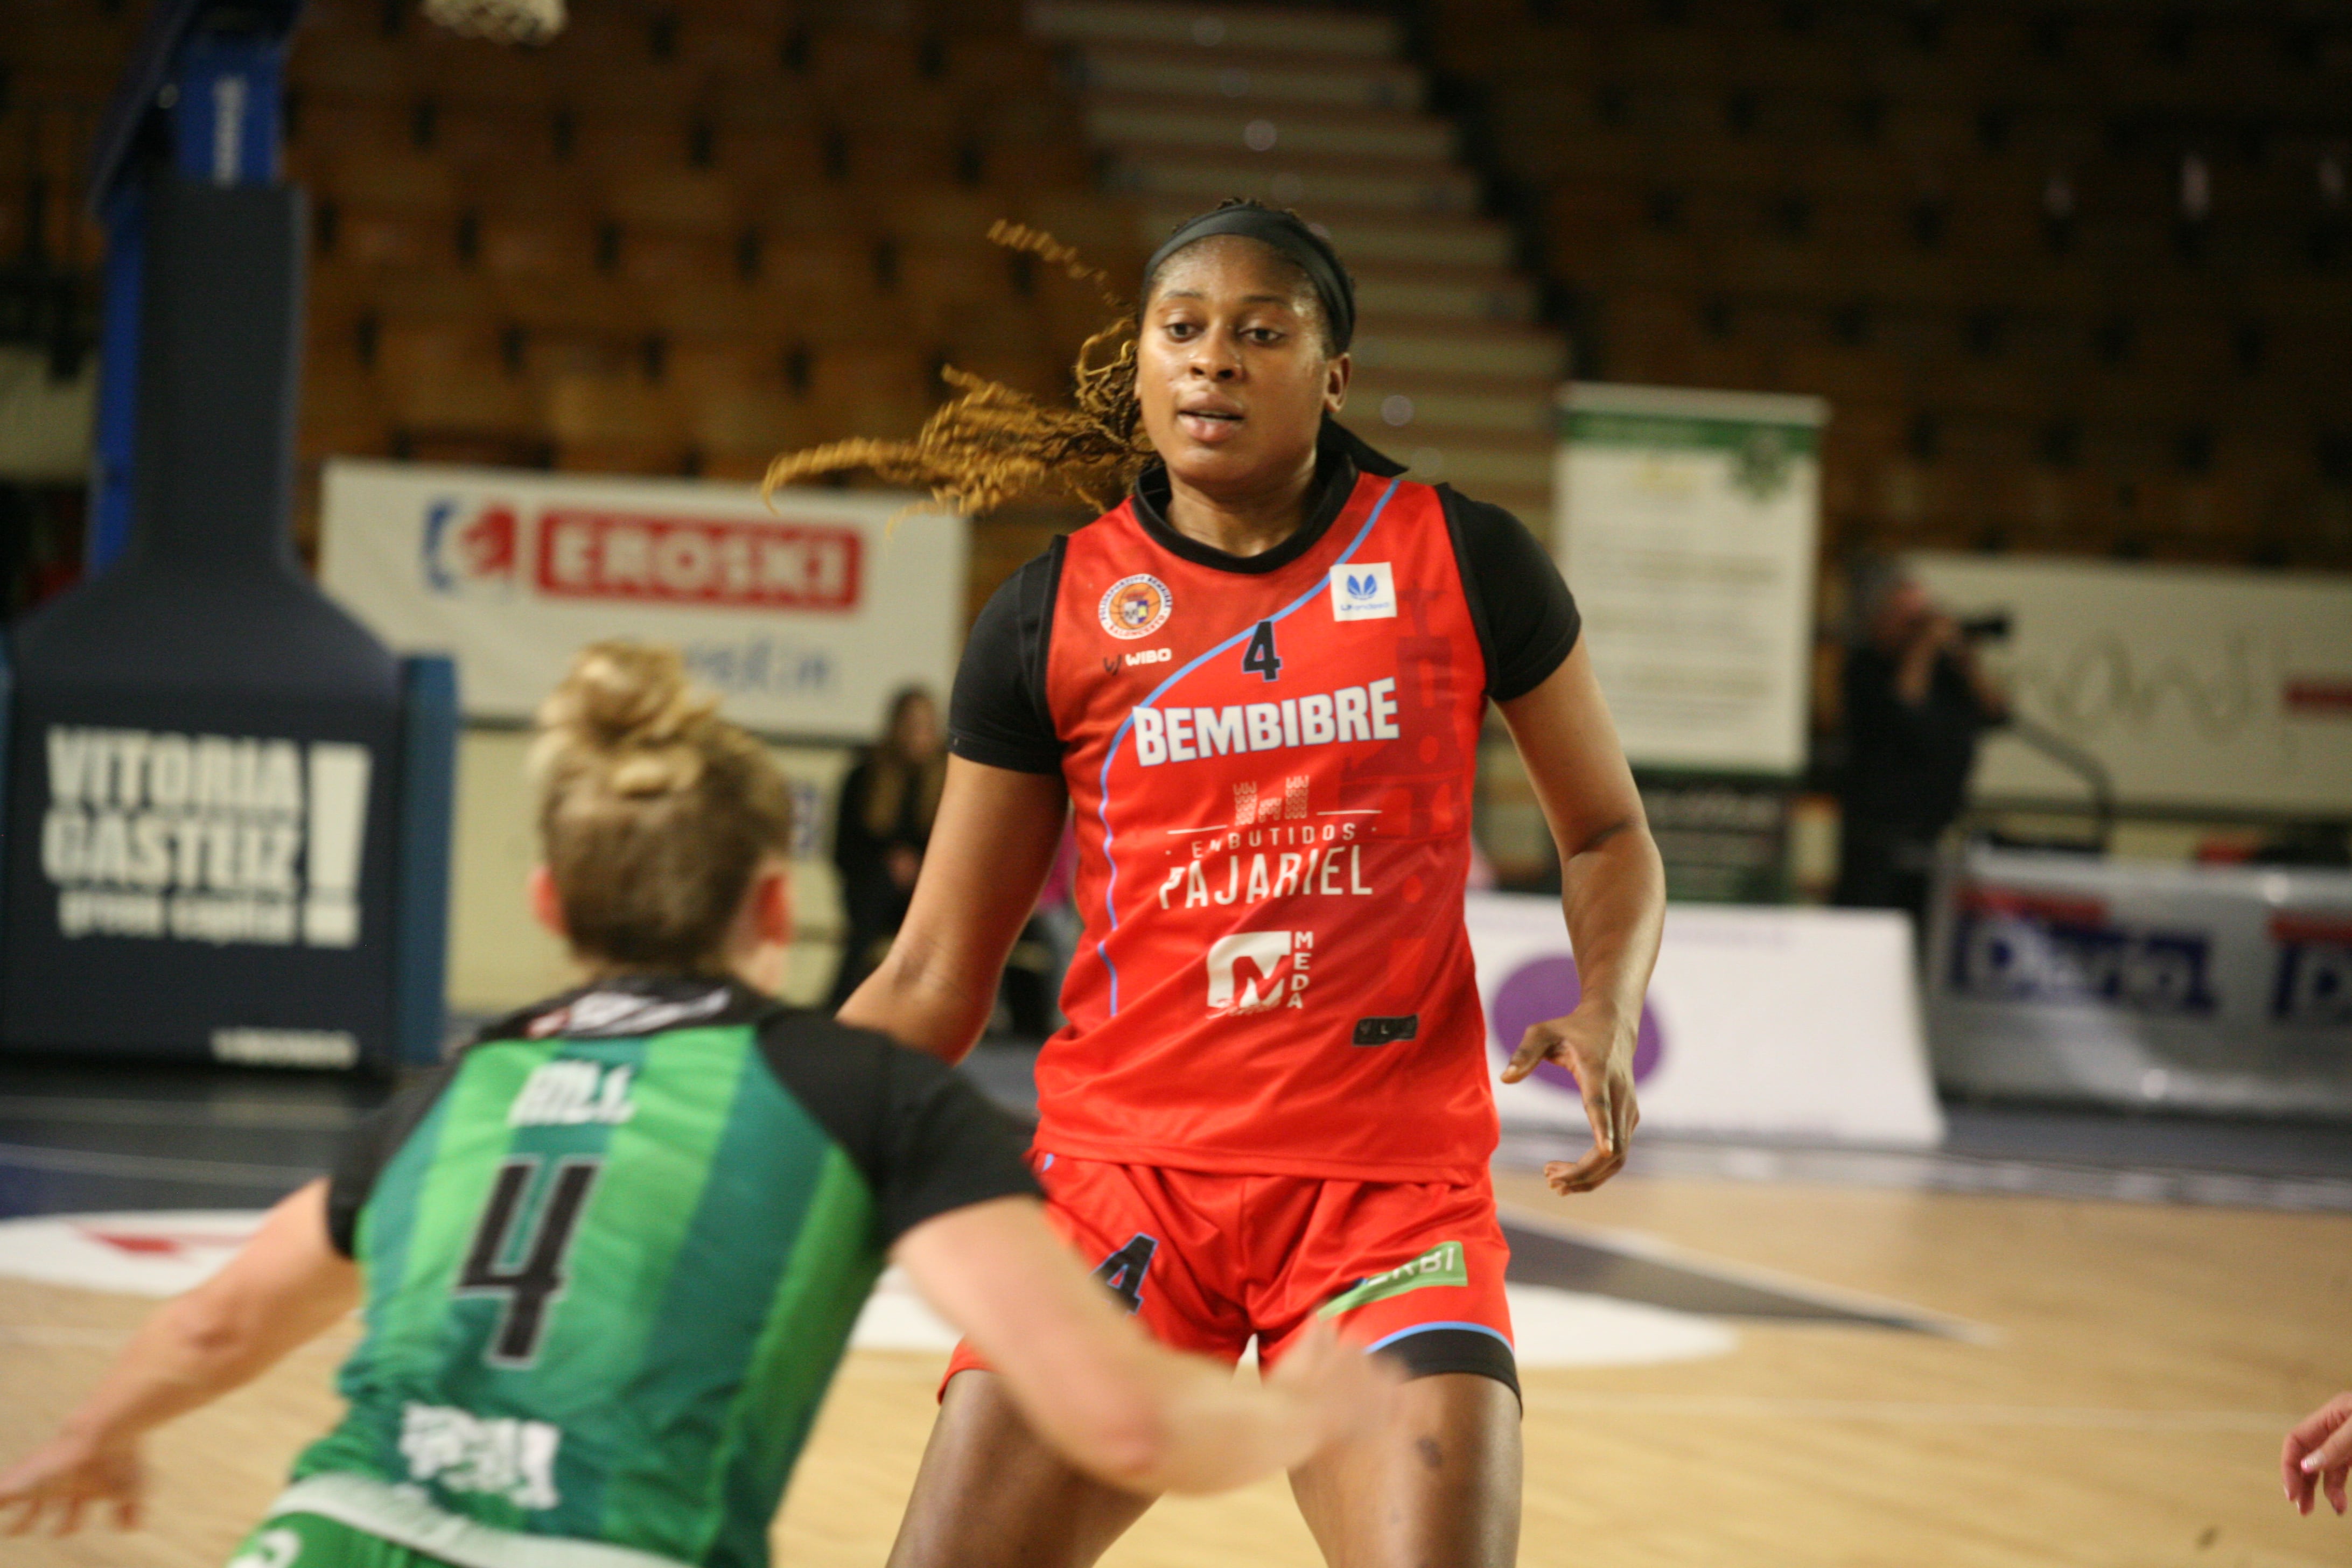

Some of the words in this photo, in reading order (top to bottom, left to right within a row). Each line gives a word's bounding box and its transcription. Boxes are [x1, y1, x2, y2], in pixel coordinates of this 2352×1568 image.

[1125, 647, 1172, 667] WIBO
[1242, 620, 1283, 683] 4
[1131, 677, 1400, 767] BEMBIBRE
[47, 725, 302, 809] VITORIA
[1158, 844, 1374, 910] PAJARIEL
[1286, 930, 1314, 1009] MEDA
[451, 1152, 604, 1369] 4
